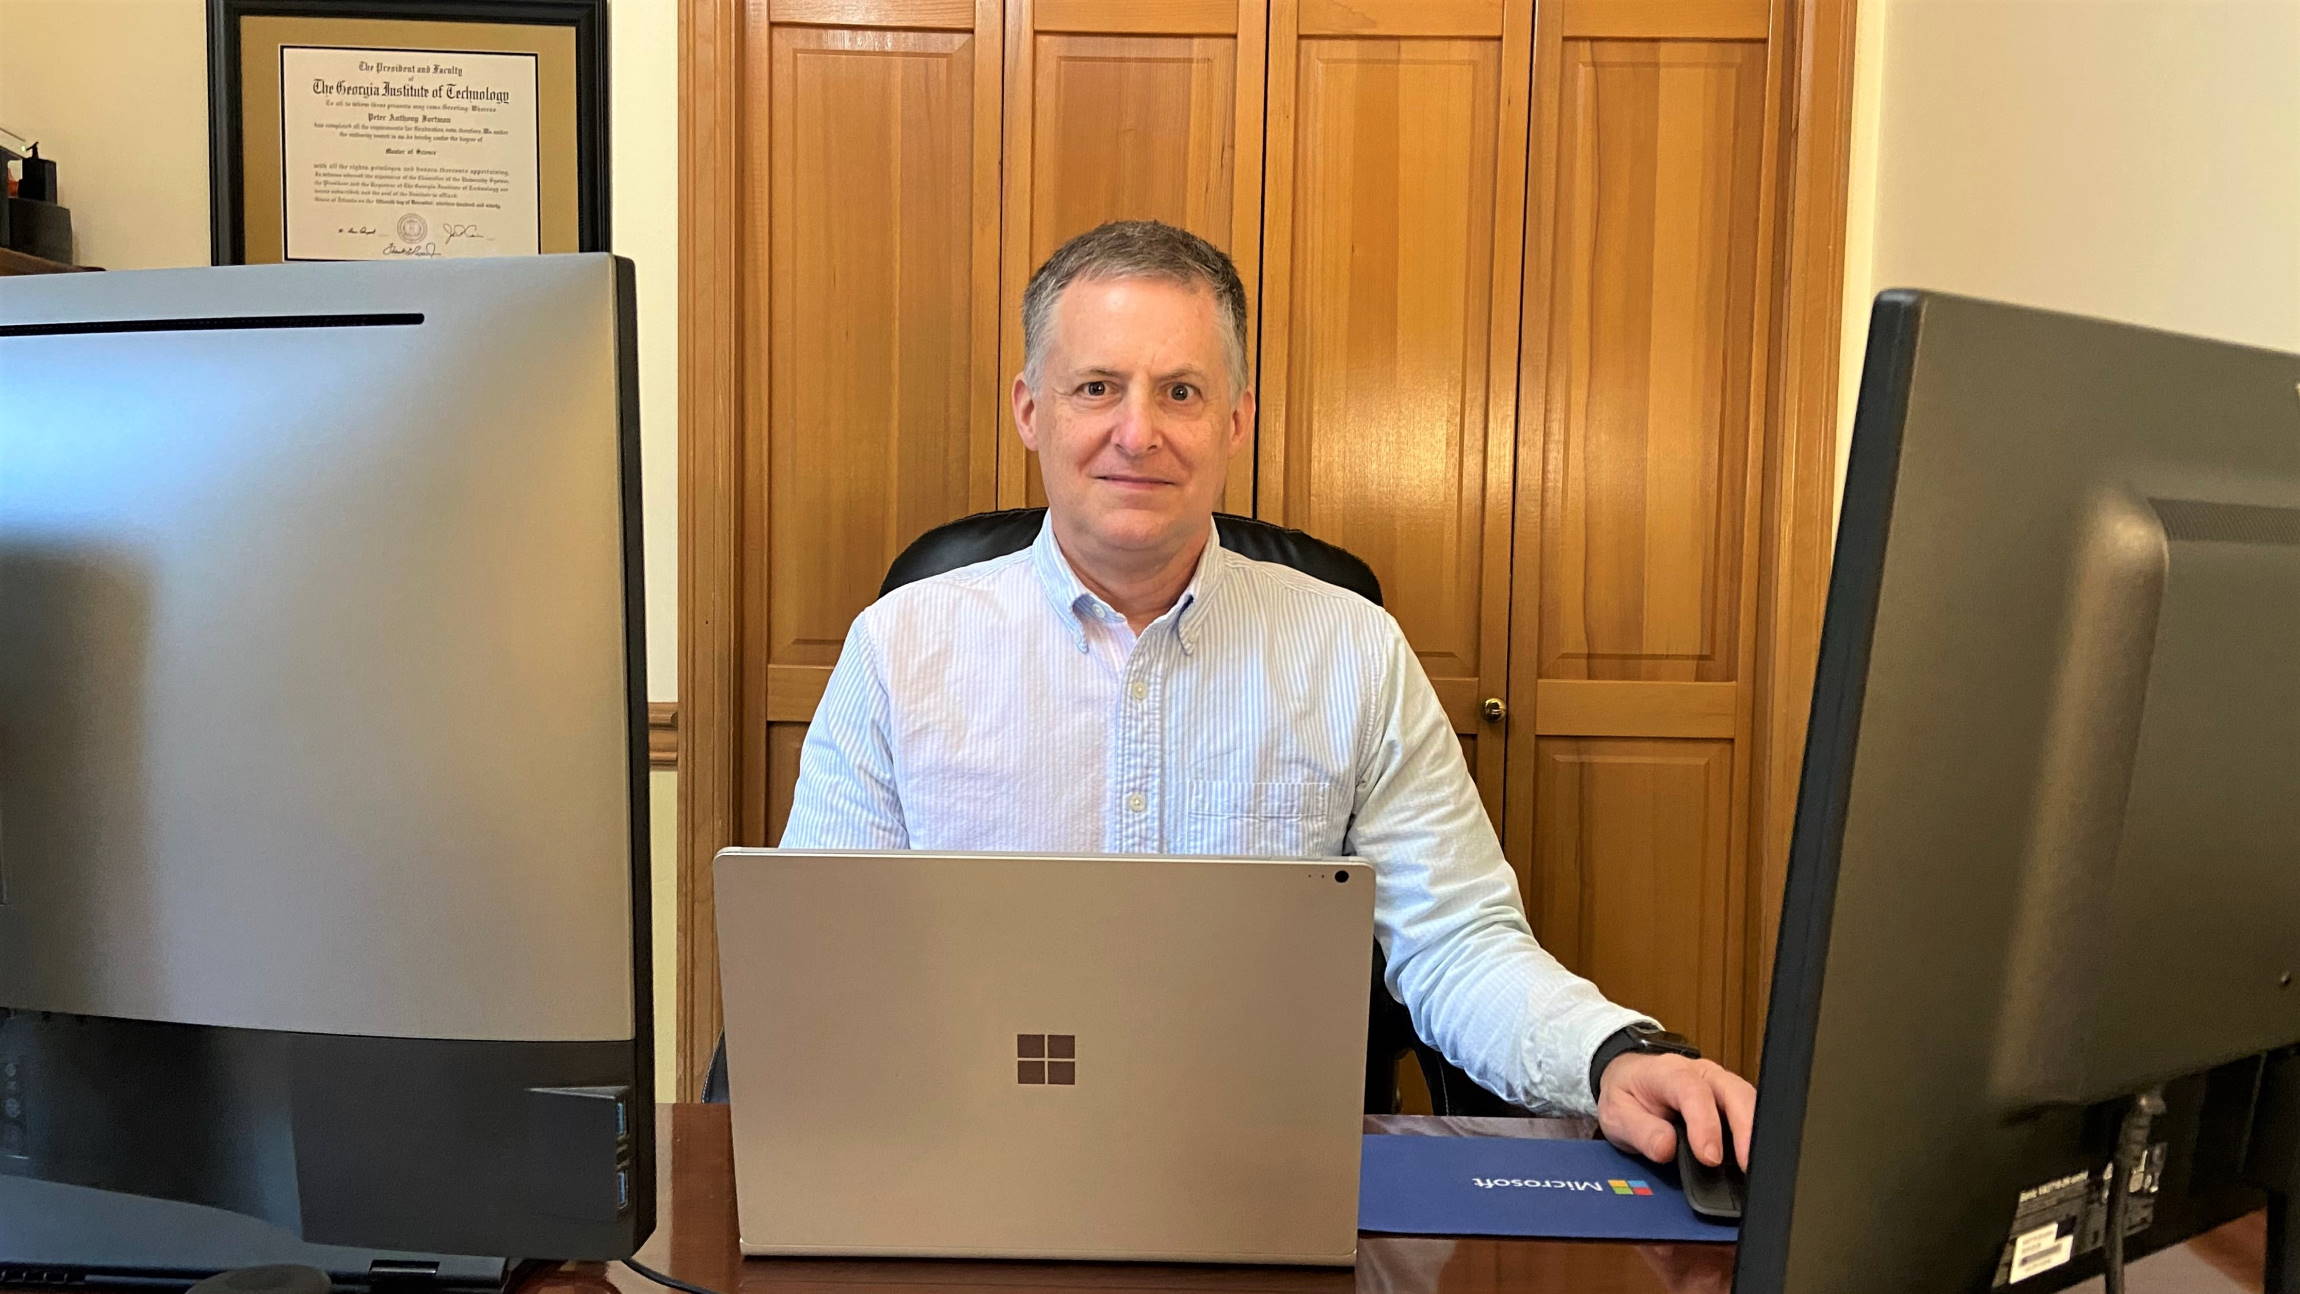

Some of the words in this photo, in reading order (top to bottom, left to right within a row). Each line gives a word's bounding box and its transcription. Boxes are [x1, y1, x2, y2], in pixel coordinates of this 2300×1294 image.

[375, 61, 415, 74] President
[416, 64, 431, 74] and
[432, 63, 463, 77] Faculty
[312, 78, 334, 96] The
[336, 79, 380, 99] Georgia
[381, 81, 429, 98] Institute
[431, 84, 444, 98] of
[446, 83, 510, 104] Technology
[1472, 1177, 1603, 1192] Microsoft
